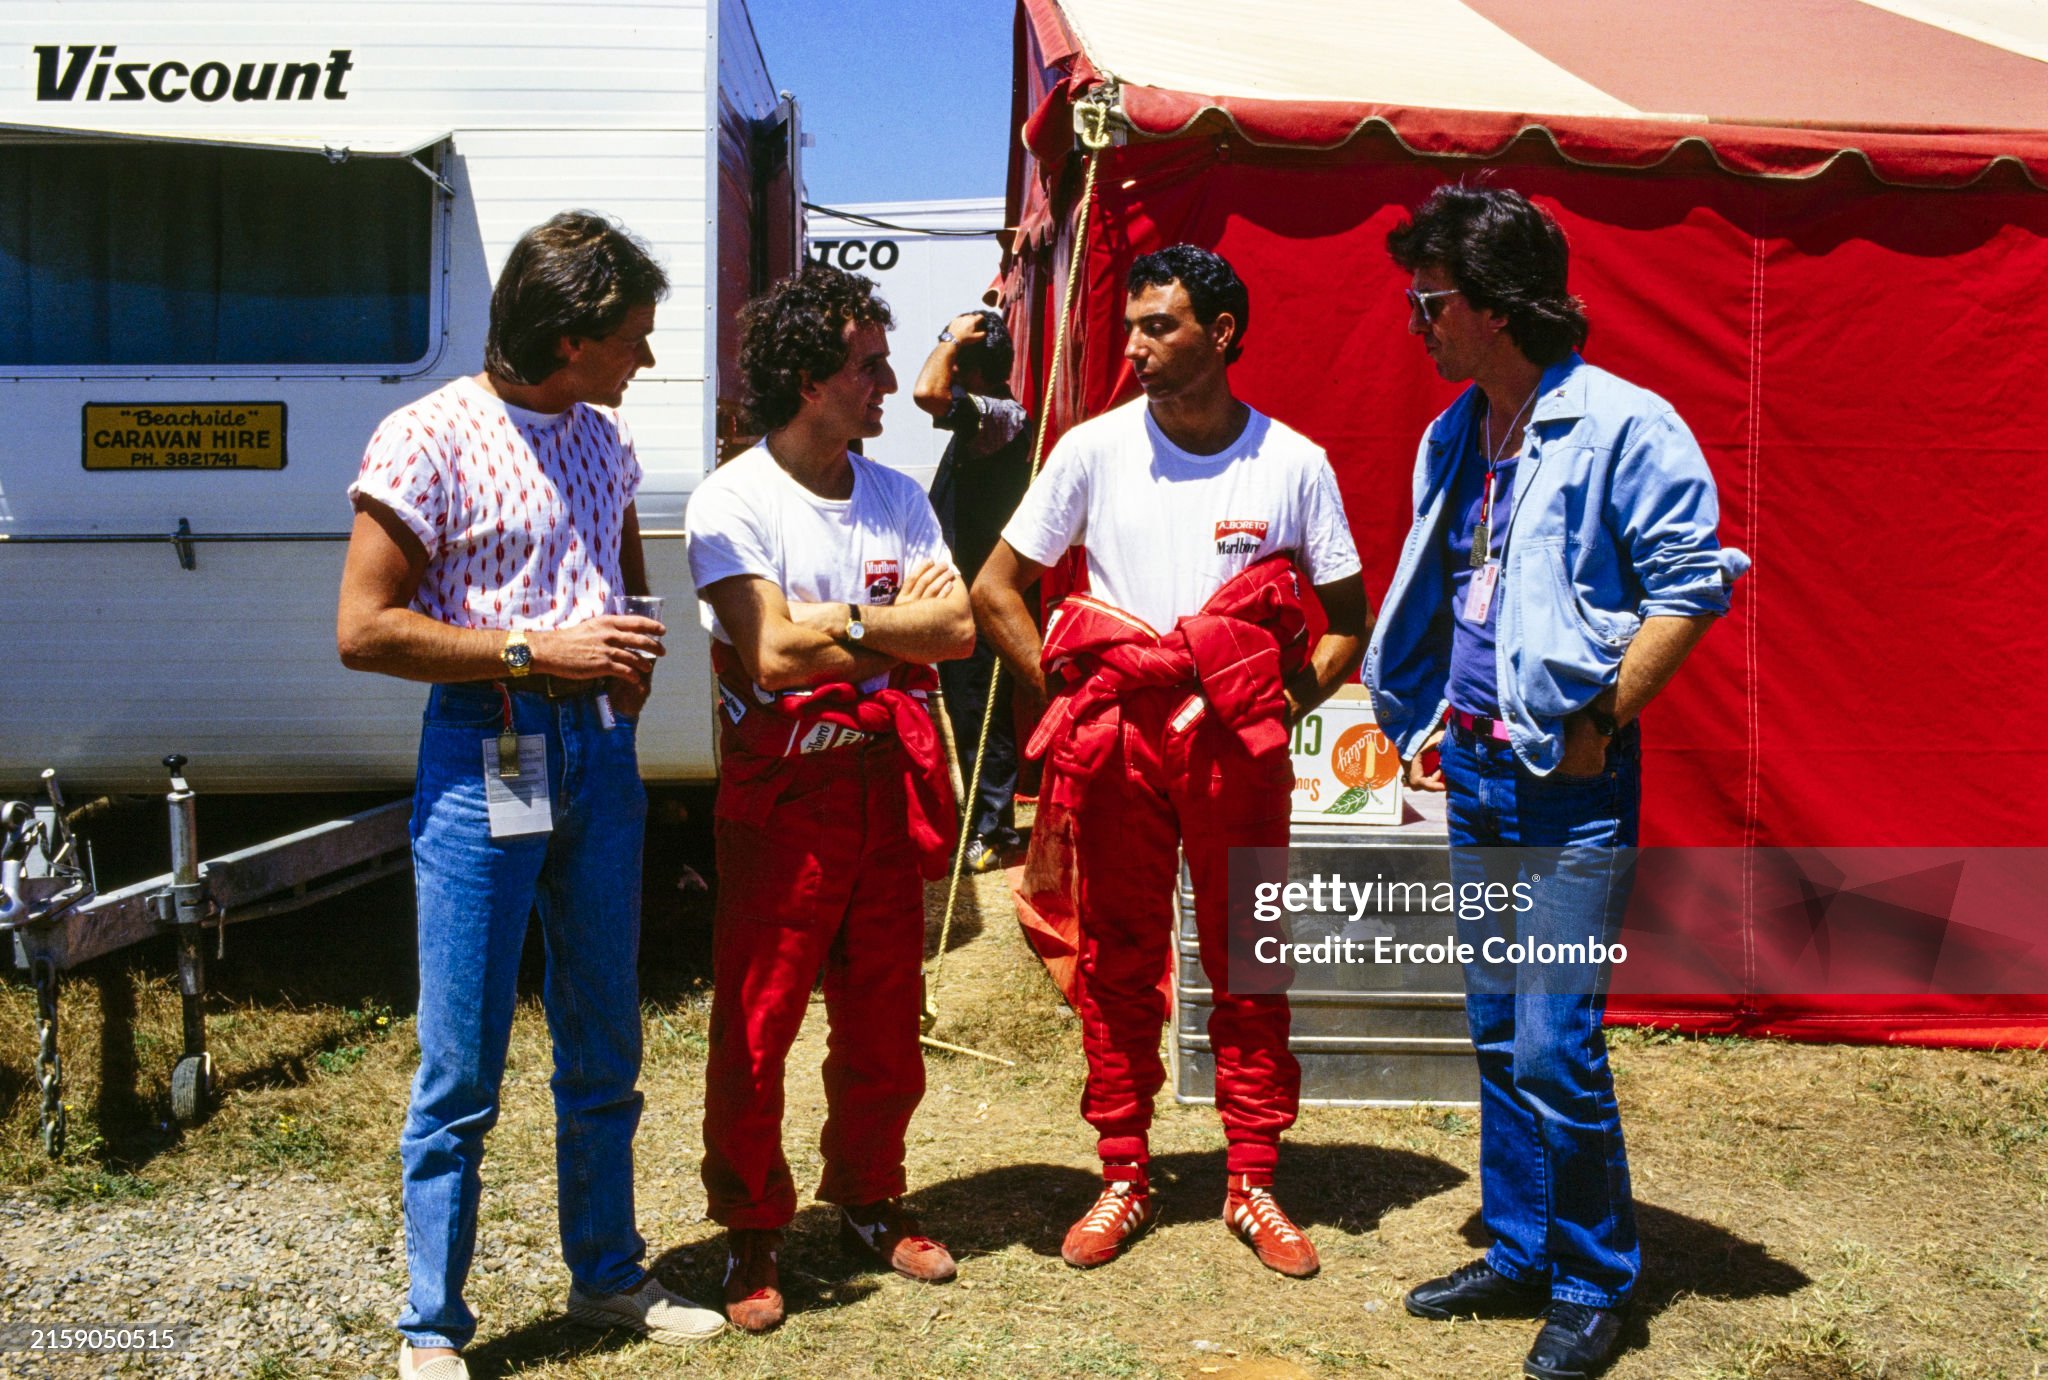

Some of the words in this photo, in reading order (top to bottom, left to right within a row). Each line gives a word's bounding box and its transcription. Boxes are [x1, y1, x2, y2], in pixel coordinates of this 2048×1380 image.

[33, 45, 354, 103] Viscount
[807, 240, 900, 271] TCO
[93, 430, 201, 449] CARAVAN
[212, 430, 270, 448] HIRE
[131, 453, 159, 465] PH.
[165, 452, 238, 466] 3821741
[1337, 728, 1389, 772] Quality
